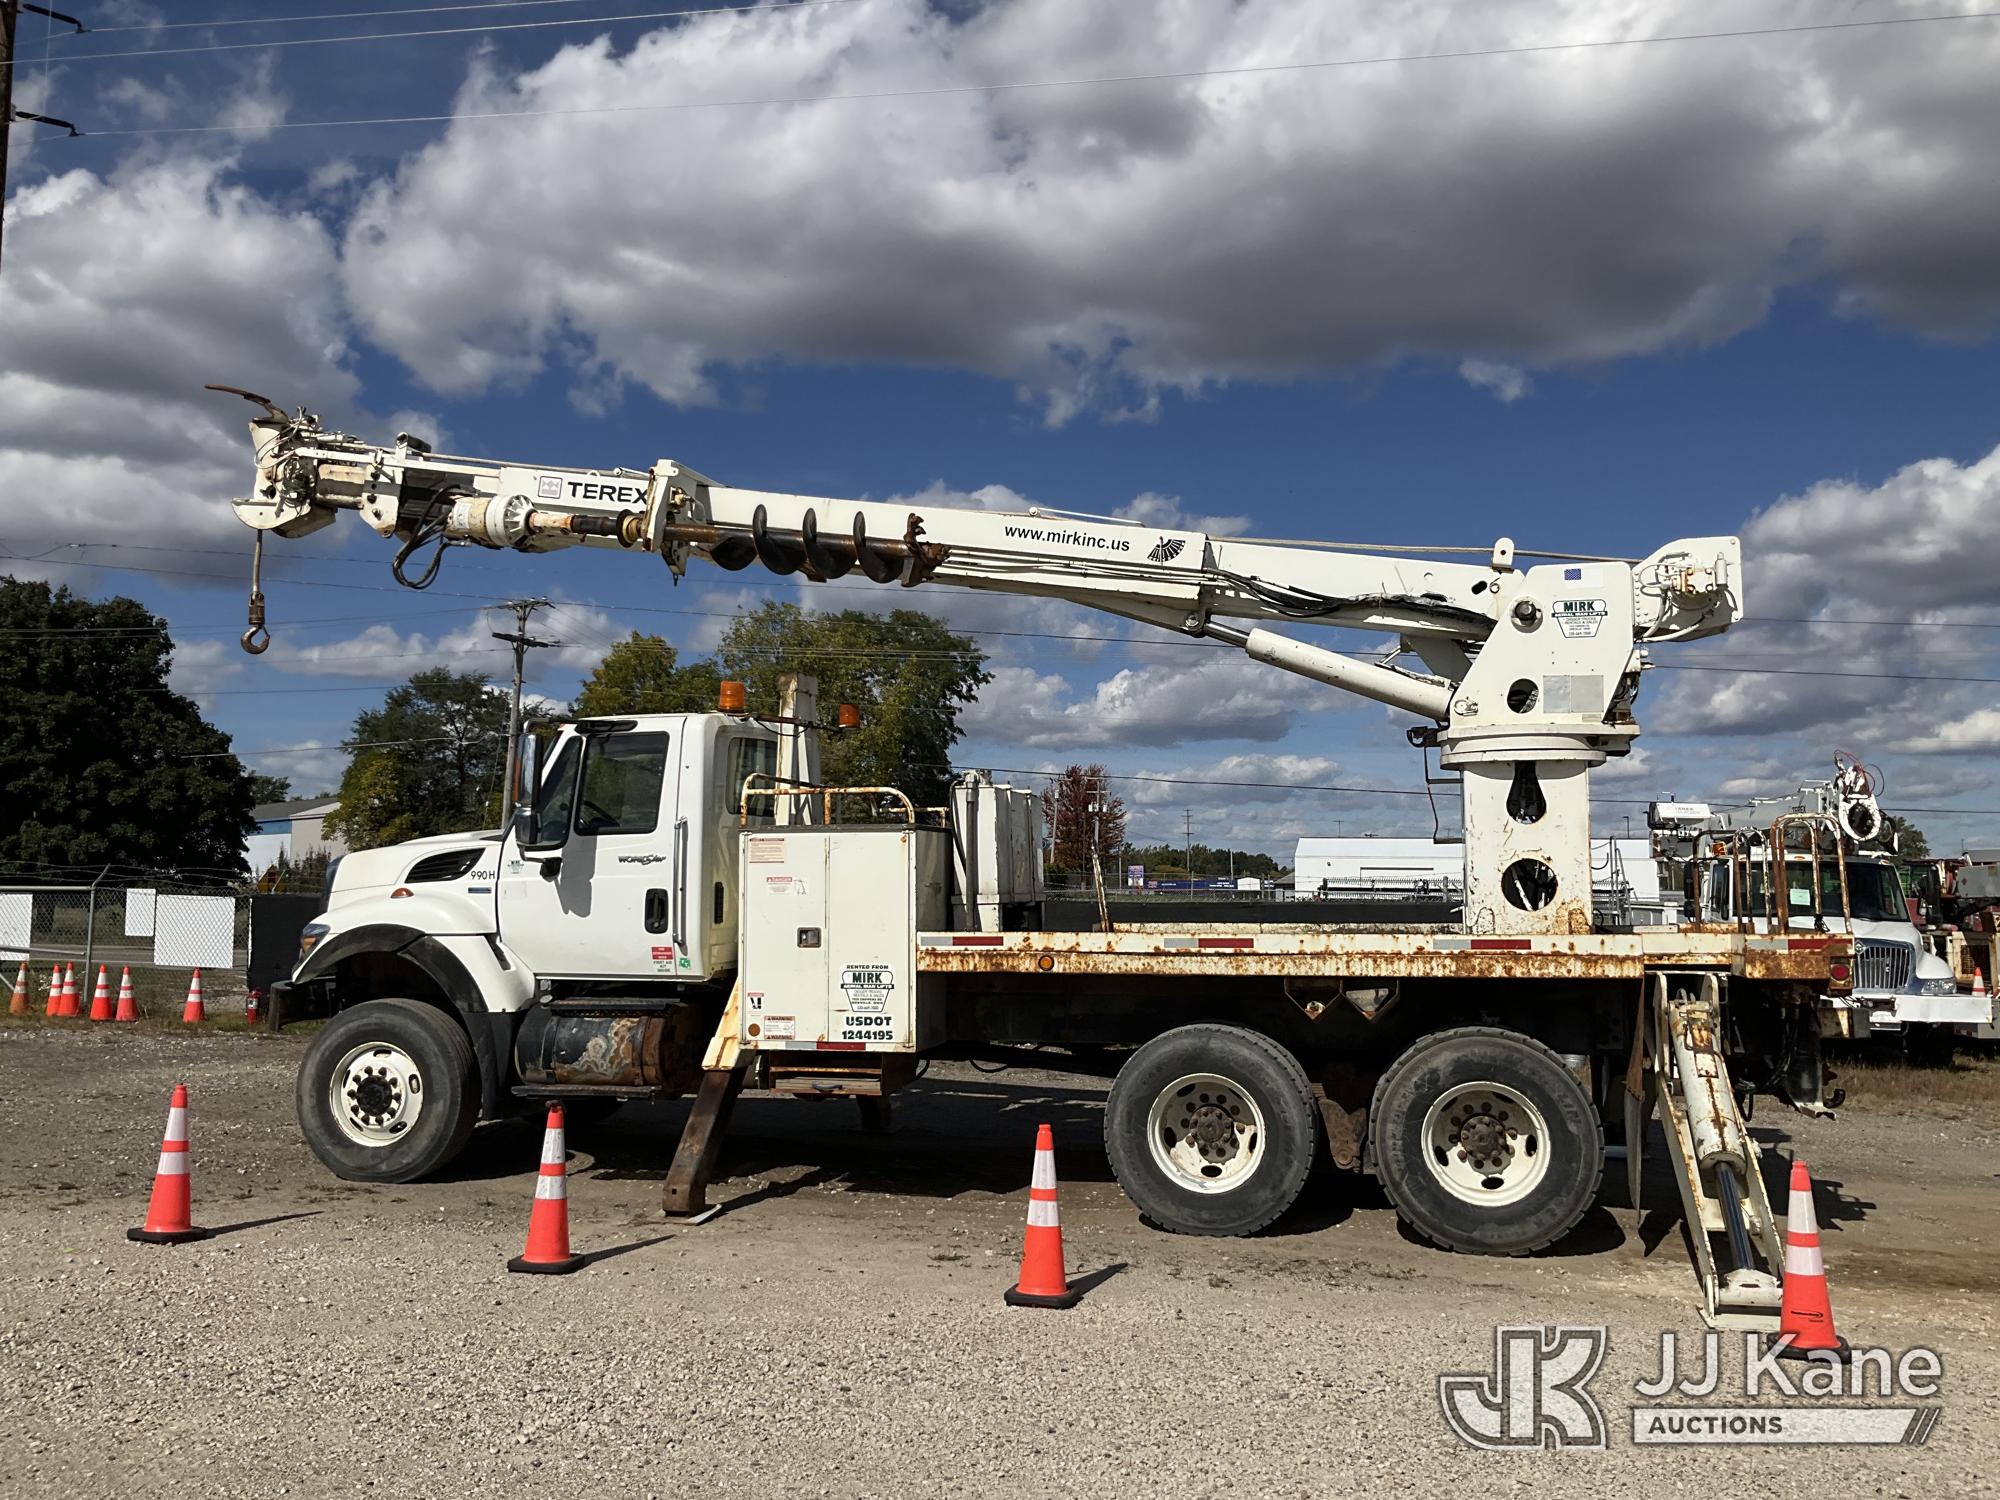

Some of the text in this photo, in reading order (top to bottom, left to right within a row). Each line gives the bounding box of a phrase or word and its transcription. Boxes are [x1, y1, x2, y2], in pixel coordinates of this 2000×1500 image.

[568, 482, 648, 504] TEREX
[1004, 526, 1130, 552] www.mirkinc.us
[1564, 601, 1595, 612] MIRK
[471, 870, 495, 880] 990 H
[852, 973, 882, 983] MIRK
[846, 1016, 892, 1026] USDOT
[842, 1030, 893, 1040] 1244195
